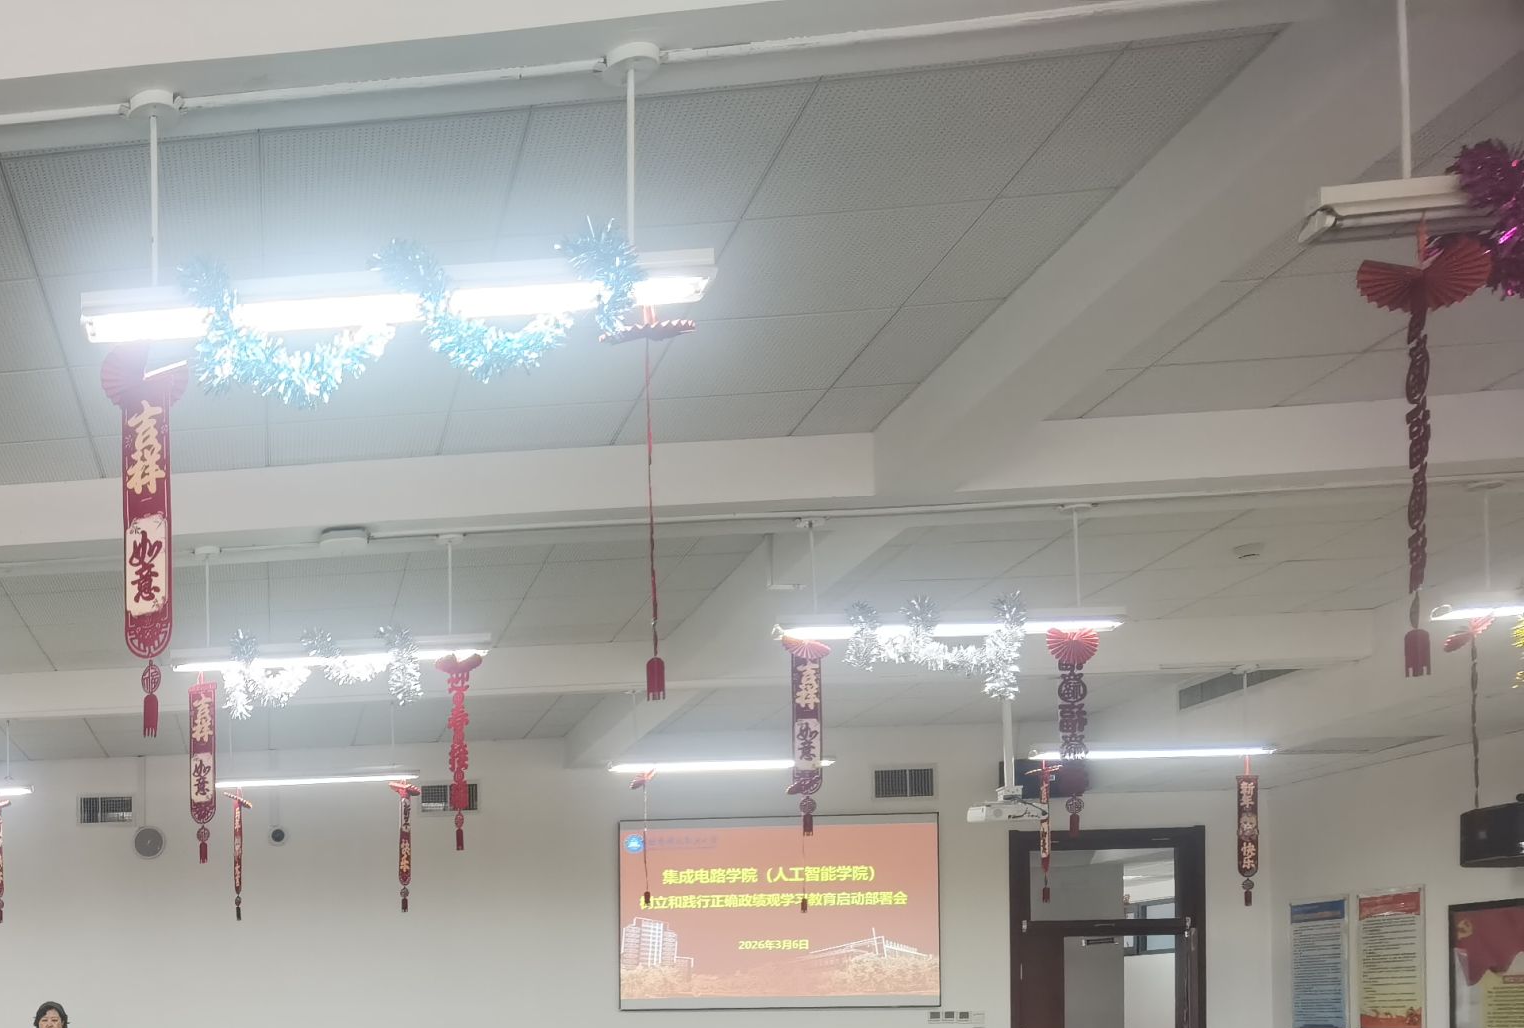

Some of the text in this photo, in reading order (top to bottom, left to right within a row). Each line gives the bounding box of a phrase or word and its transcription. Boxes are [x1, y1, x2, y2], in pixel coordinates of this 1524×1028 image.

[662, 866, 879, 884] 集成电路学院（人工智能学院）
[738, 939, 809, 951] 2026年3月6日
